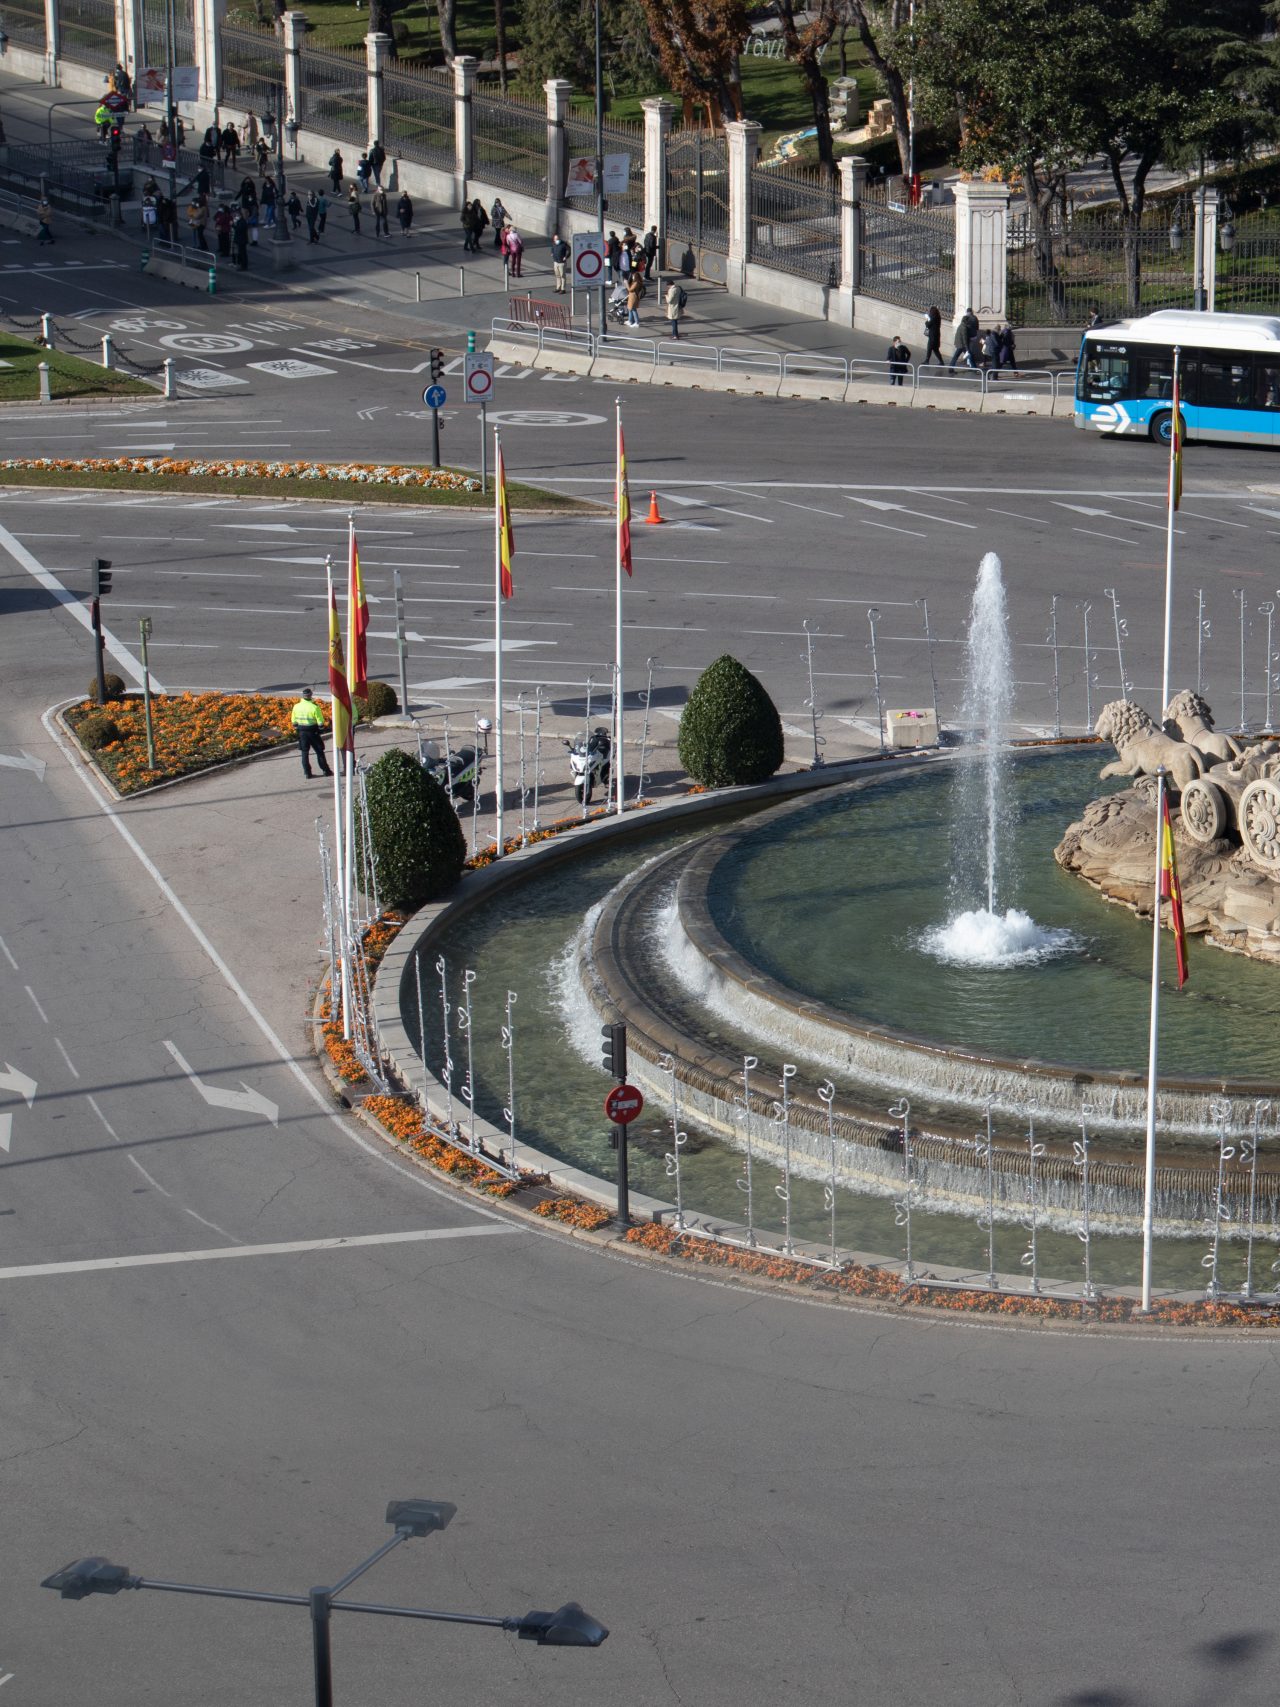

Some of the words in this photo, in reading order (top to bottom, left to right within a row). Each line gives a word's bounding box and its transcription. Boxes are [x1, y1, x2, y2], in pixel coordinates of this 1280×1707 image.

[226, 320, 305, 334] TAXI
[180, 337, 236, 349] 30
[303, 338, 377, 352] BUS
